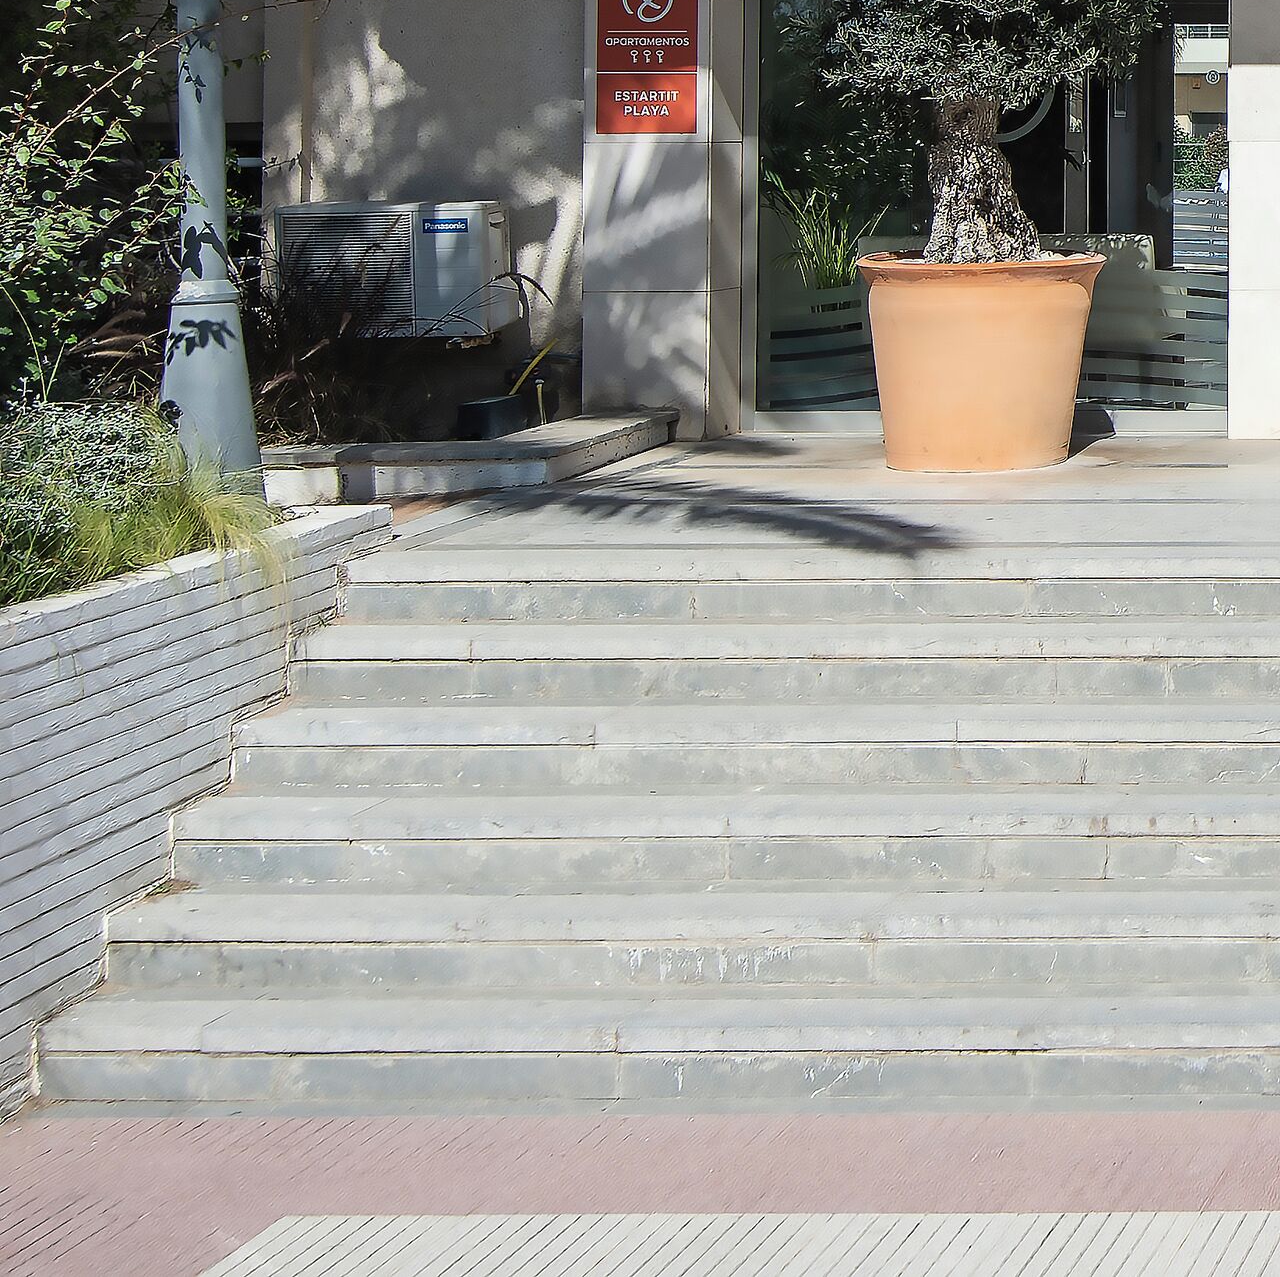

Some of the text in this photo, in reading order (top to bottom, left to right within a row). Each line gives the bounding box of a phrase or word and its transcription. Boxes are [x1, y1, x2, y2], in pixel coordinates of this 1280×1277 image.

[614, 90, 680, 102] ESTARTIT
[623, 105, 670, 116] PLAYA
[424, 221, 466, 230] Panasonic
